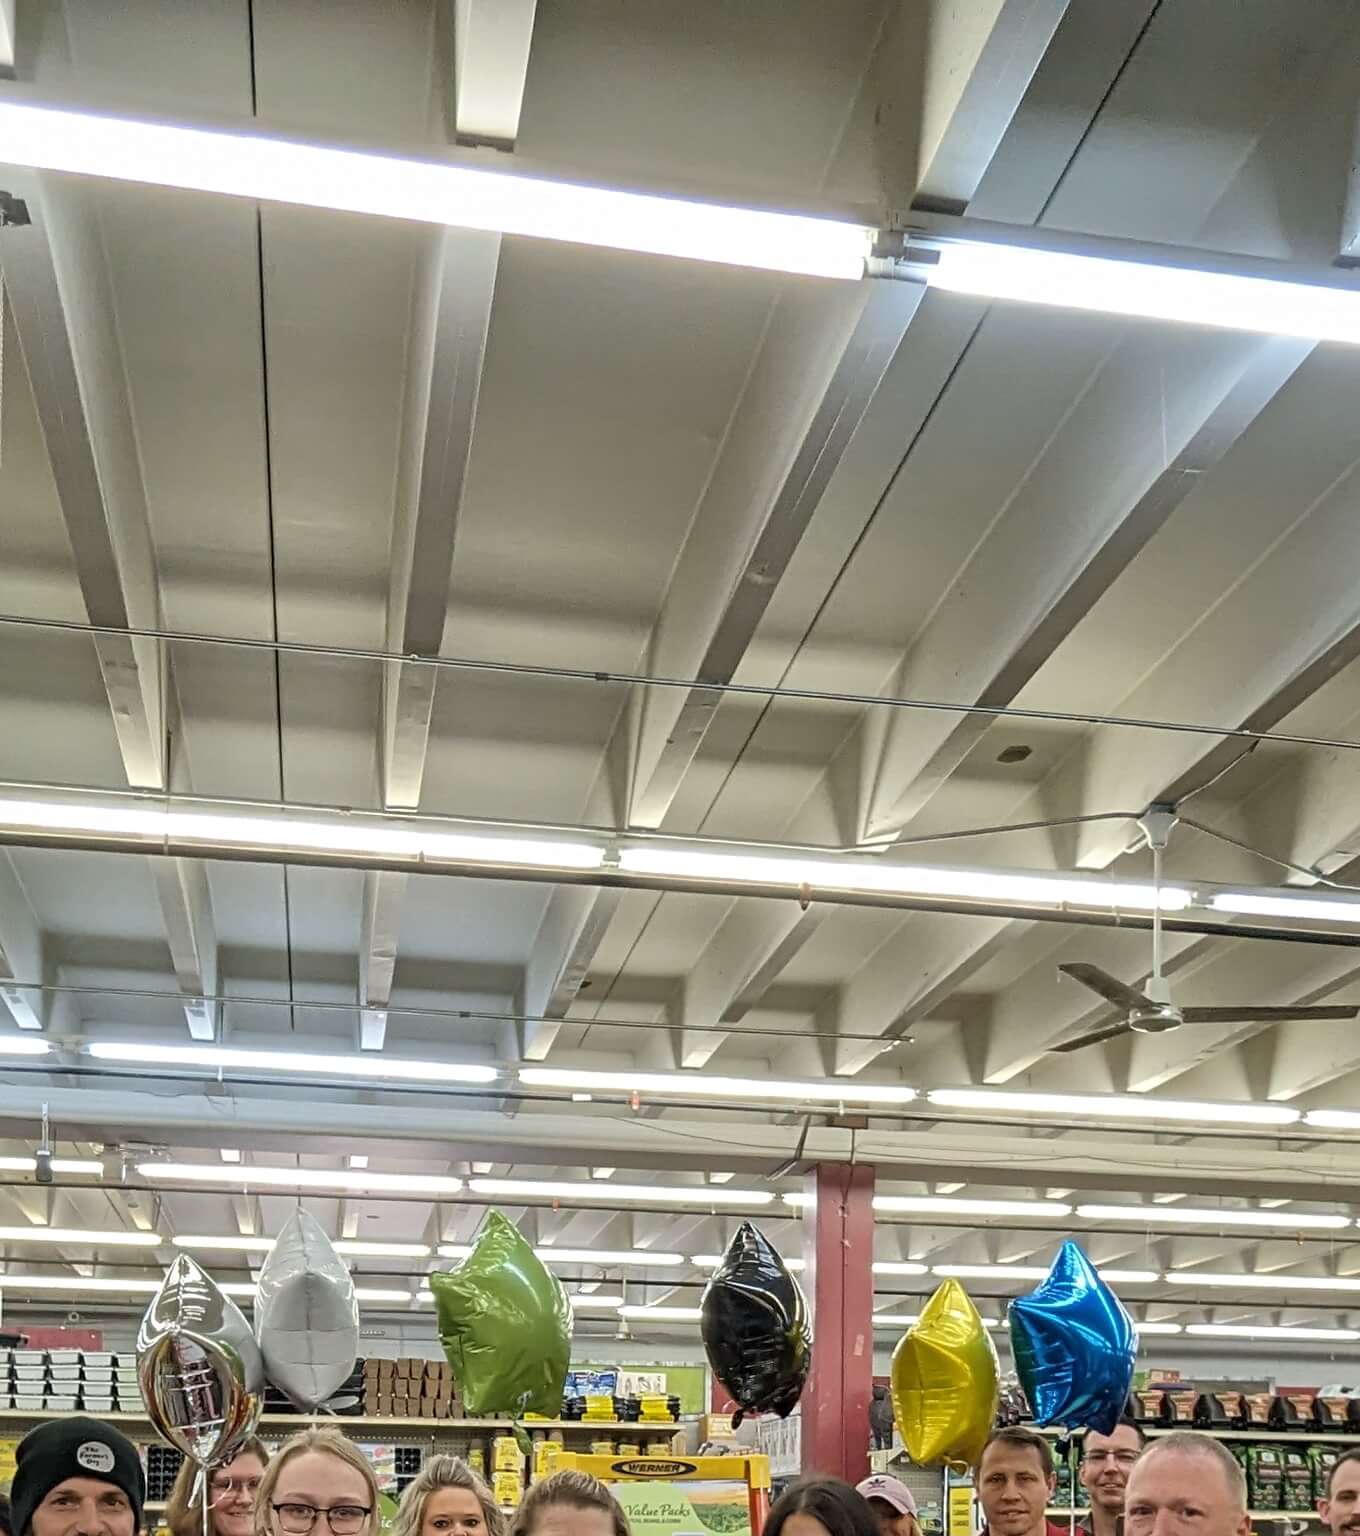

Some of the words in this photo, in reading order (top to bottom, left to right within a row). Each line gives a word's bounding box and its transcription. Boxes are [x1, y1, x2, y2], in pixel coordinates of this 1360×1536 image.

[628, 1463, 681, 1473] WERNER
[624, 1503, 658, 1517] Value
[658, 1503, 691, 1517] Packs
